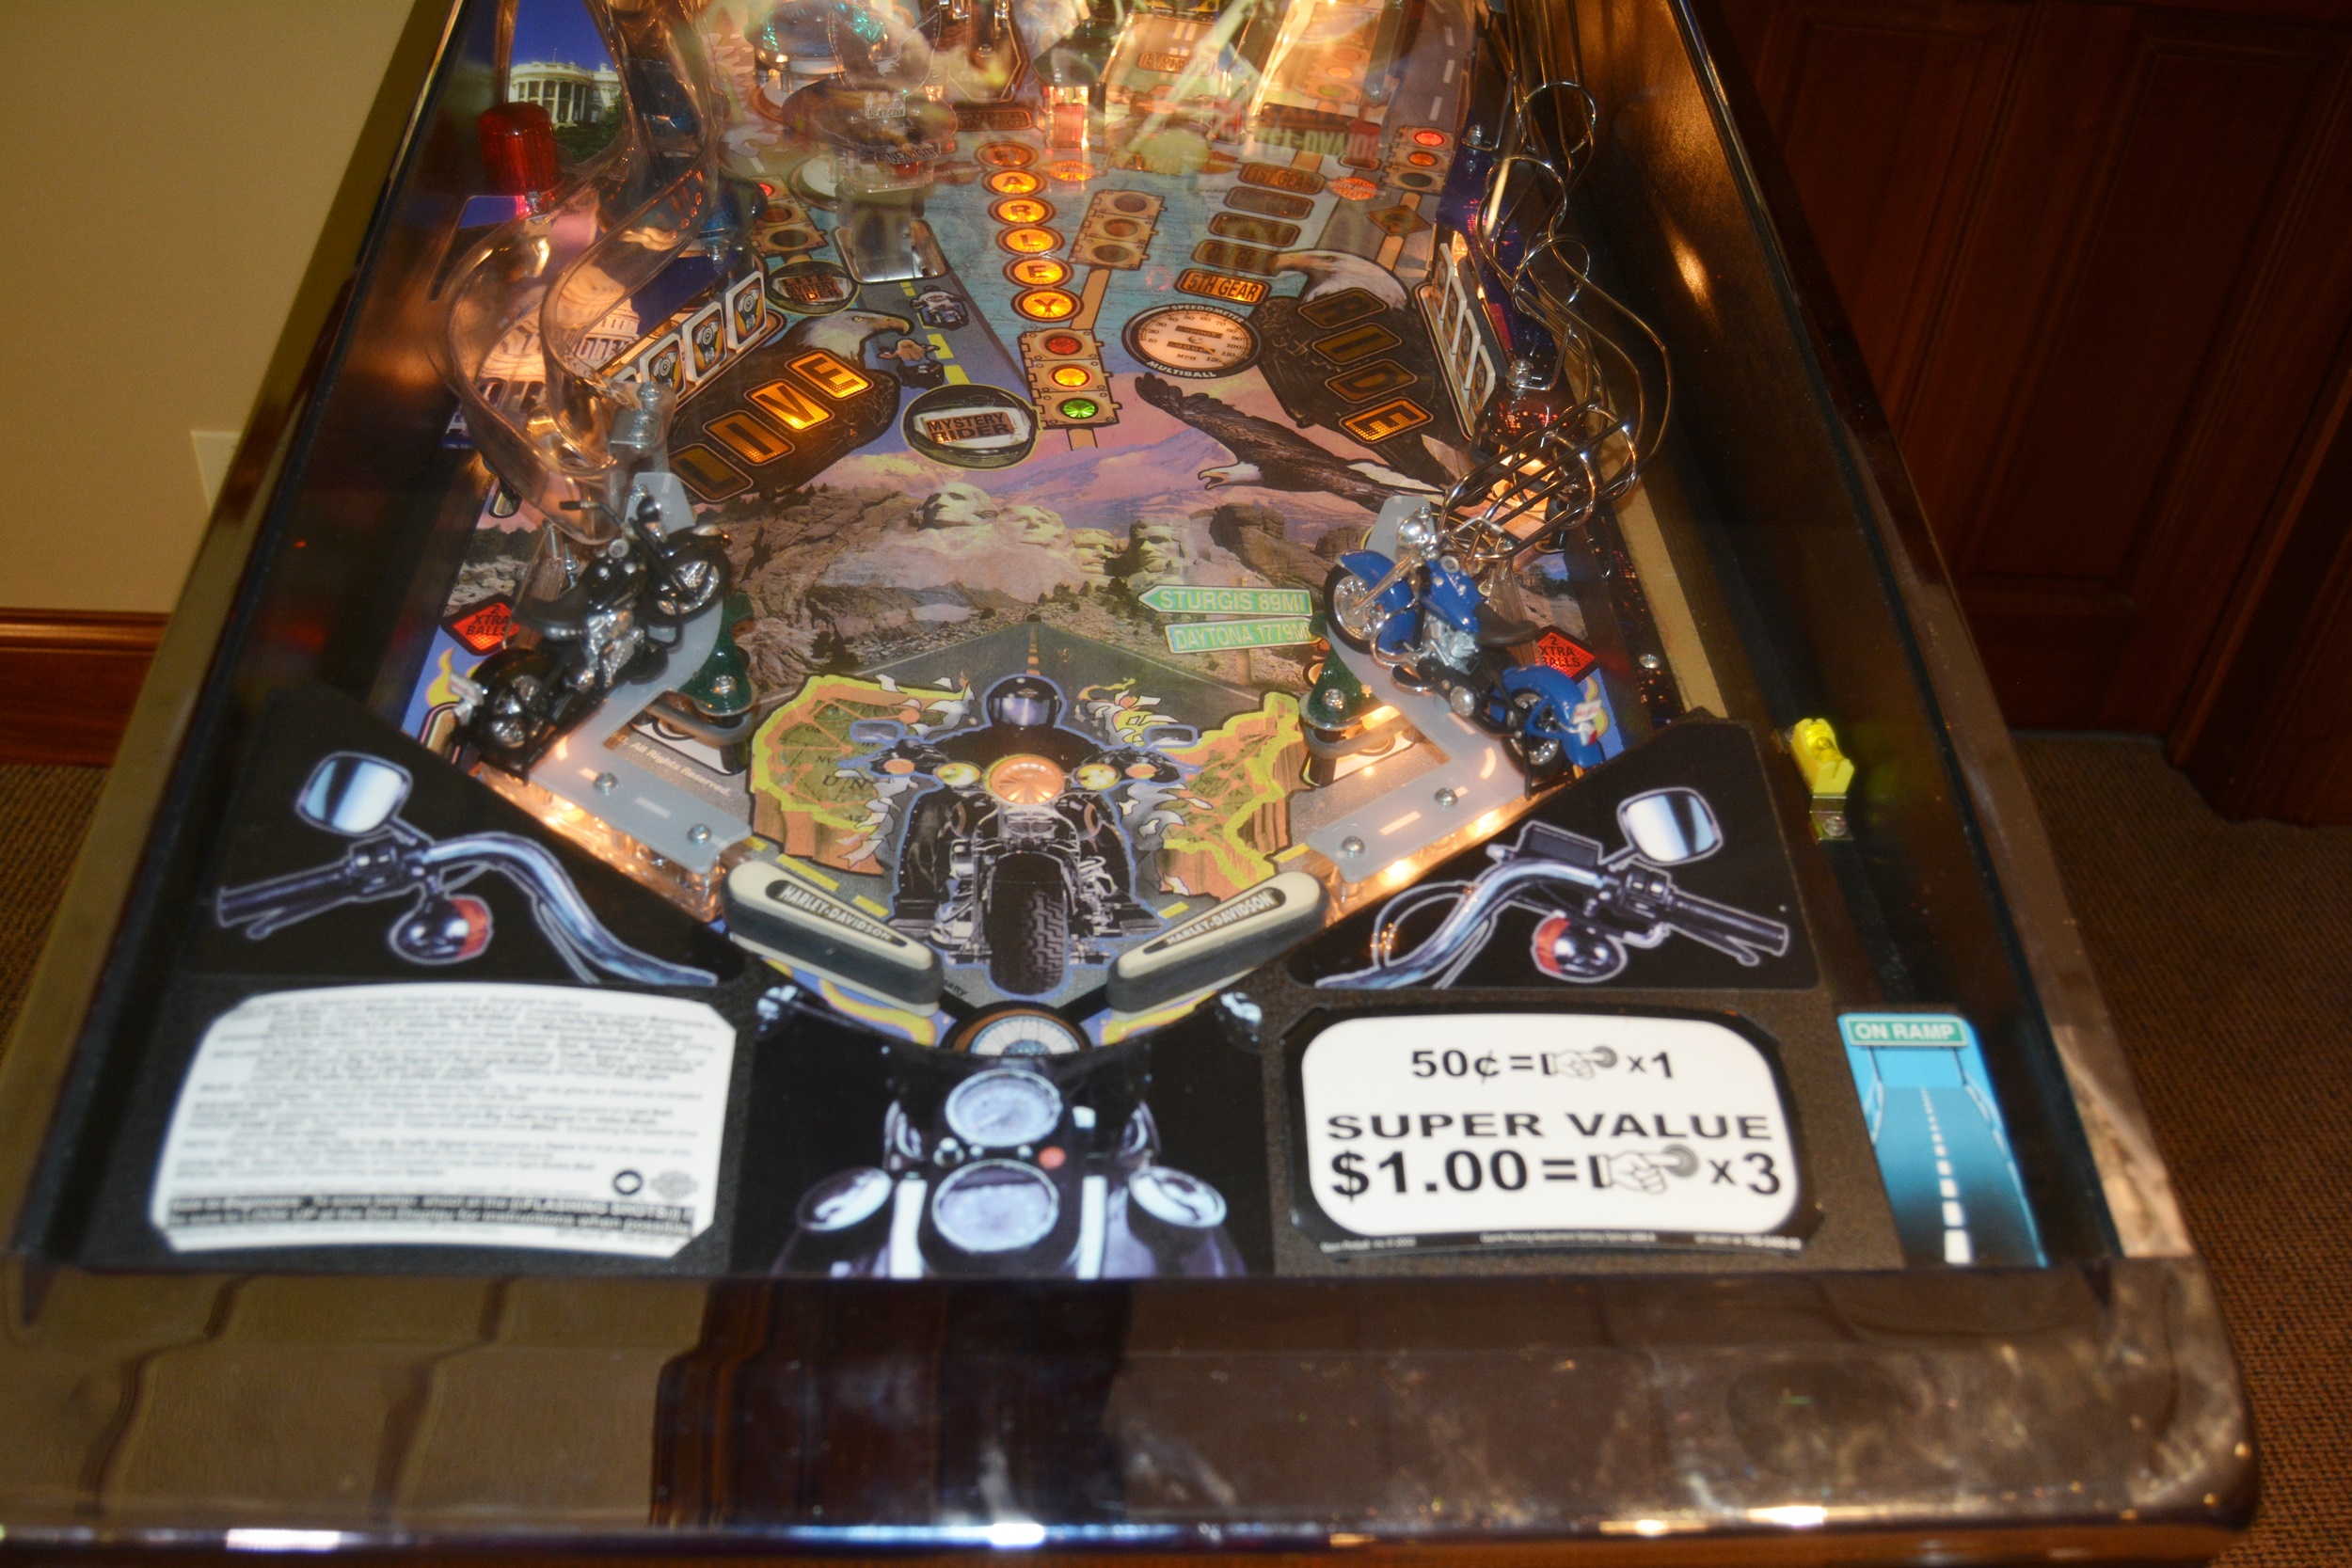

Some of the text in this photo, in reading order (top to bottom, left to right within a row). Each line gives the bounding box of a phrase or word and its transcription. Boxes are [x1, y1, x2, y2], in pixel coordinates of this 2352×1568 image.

[1187, 273, 1260, 301] 5TH GEAR
[1171, 304, 1245, 324] SPEEDOMETER
[1146, 360, 1217, 378] MULTIBALL
[926, 412, 1005, 433] MYSTERY
[930, 423, 1011, 443] RIDER
[490, 604, 501, 614] 2
[1160, 590, 1306, 612] STURGIS 89MI
[472, 614, 511, 626] XTRA
[466, 625, 509, 636] BALLS
[1175, 625, 1255, 650] DAYTONA
[1549, 635, 1558, 646] 2
[1538, 645, 1576, 657] XTRA
[629, 742, 649, 753] All
[646, 749, 681, 770] Rights
[1854, 1022, 1956, 1041] ON RAMP
[1327, 1112, 1773, 1142] SUPER VALUE
